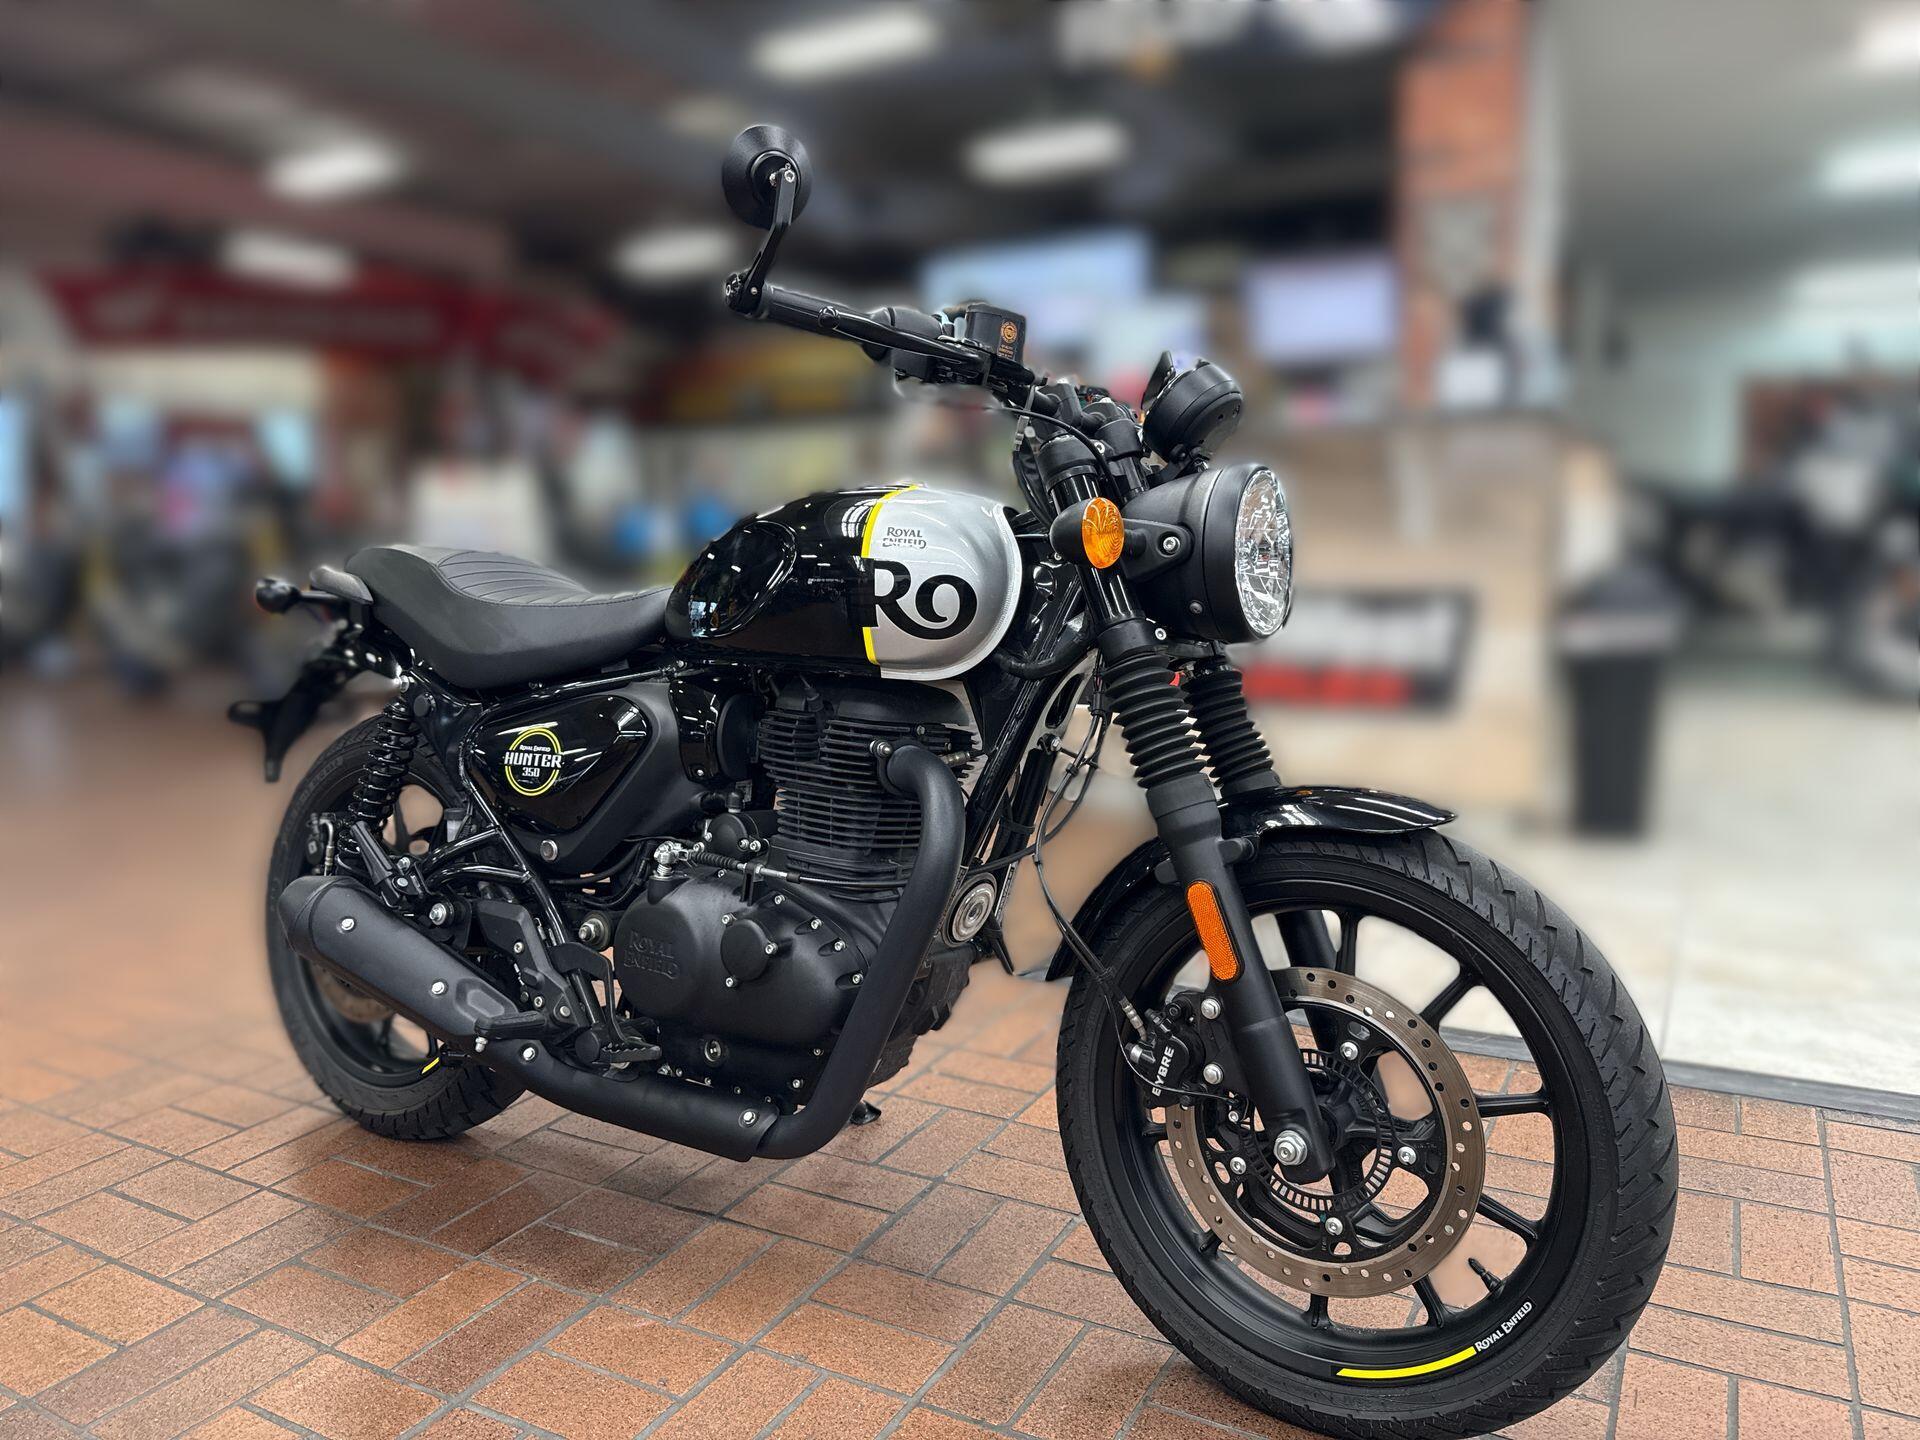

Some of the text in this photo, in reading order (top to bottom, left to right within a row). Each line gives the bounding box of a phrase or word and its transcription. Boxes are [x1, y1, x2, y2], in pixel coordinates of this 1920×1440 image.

[886, 526, 923, 537] ROYAL
[504, 752, 562, 768] HUNTER
[522, 767, 540, 777] 350
[1474, 1301, 1533, 1352] ROYAL ENFIELD
